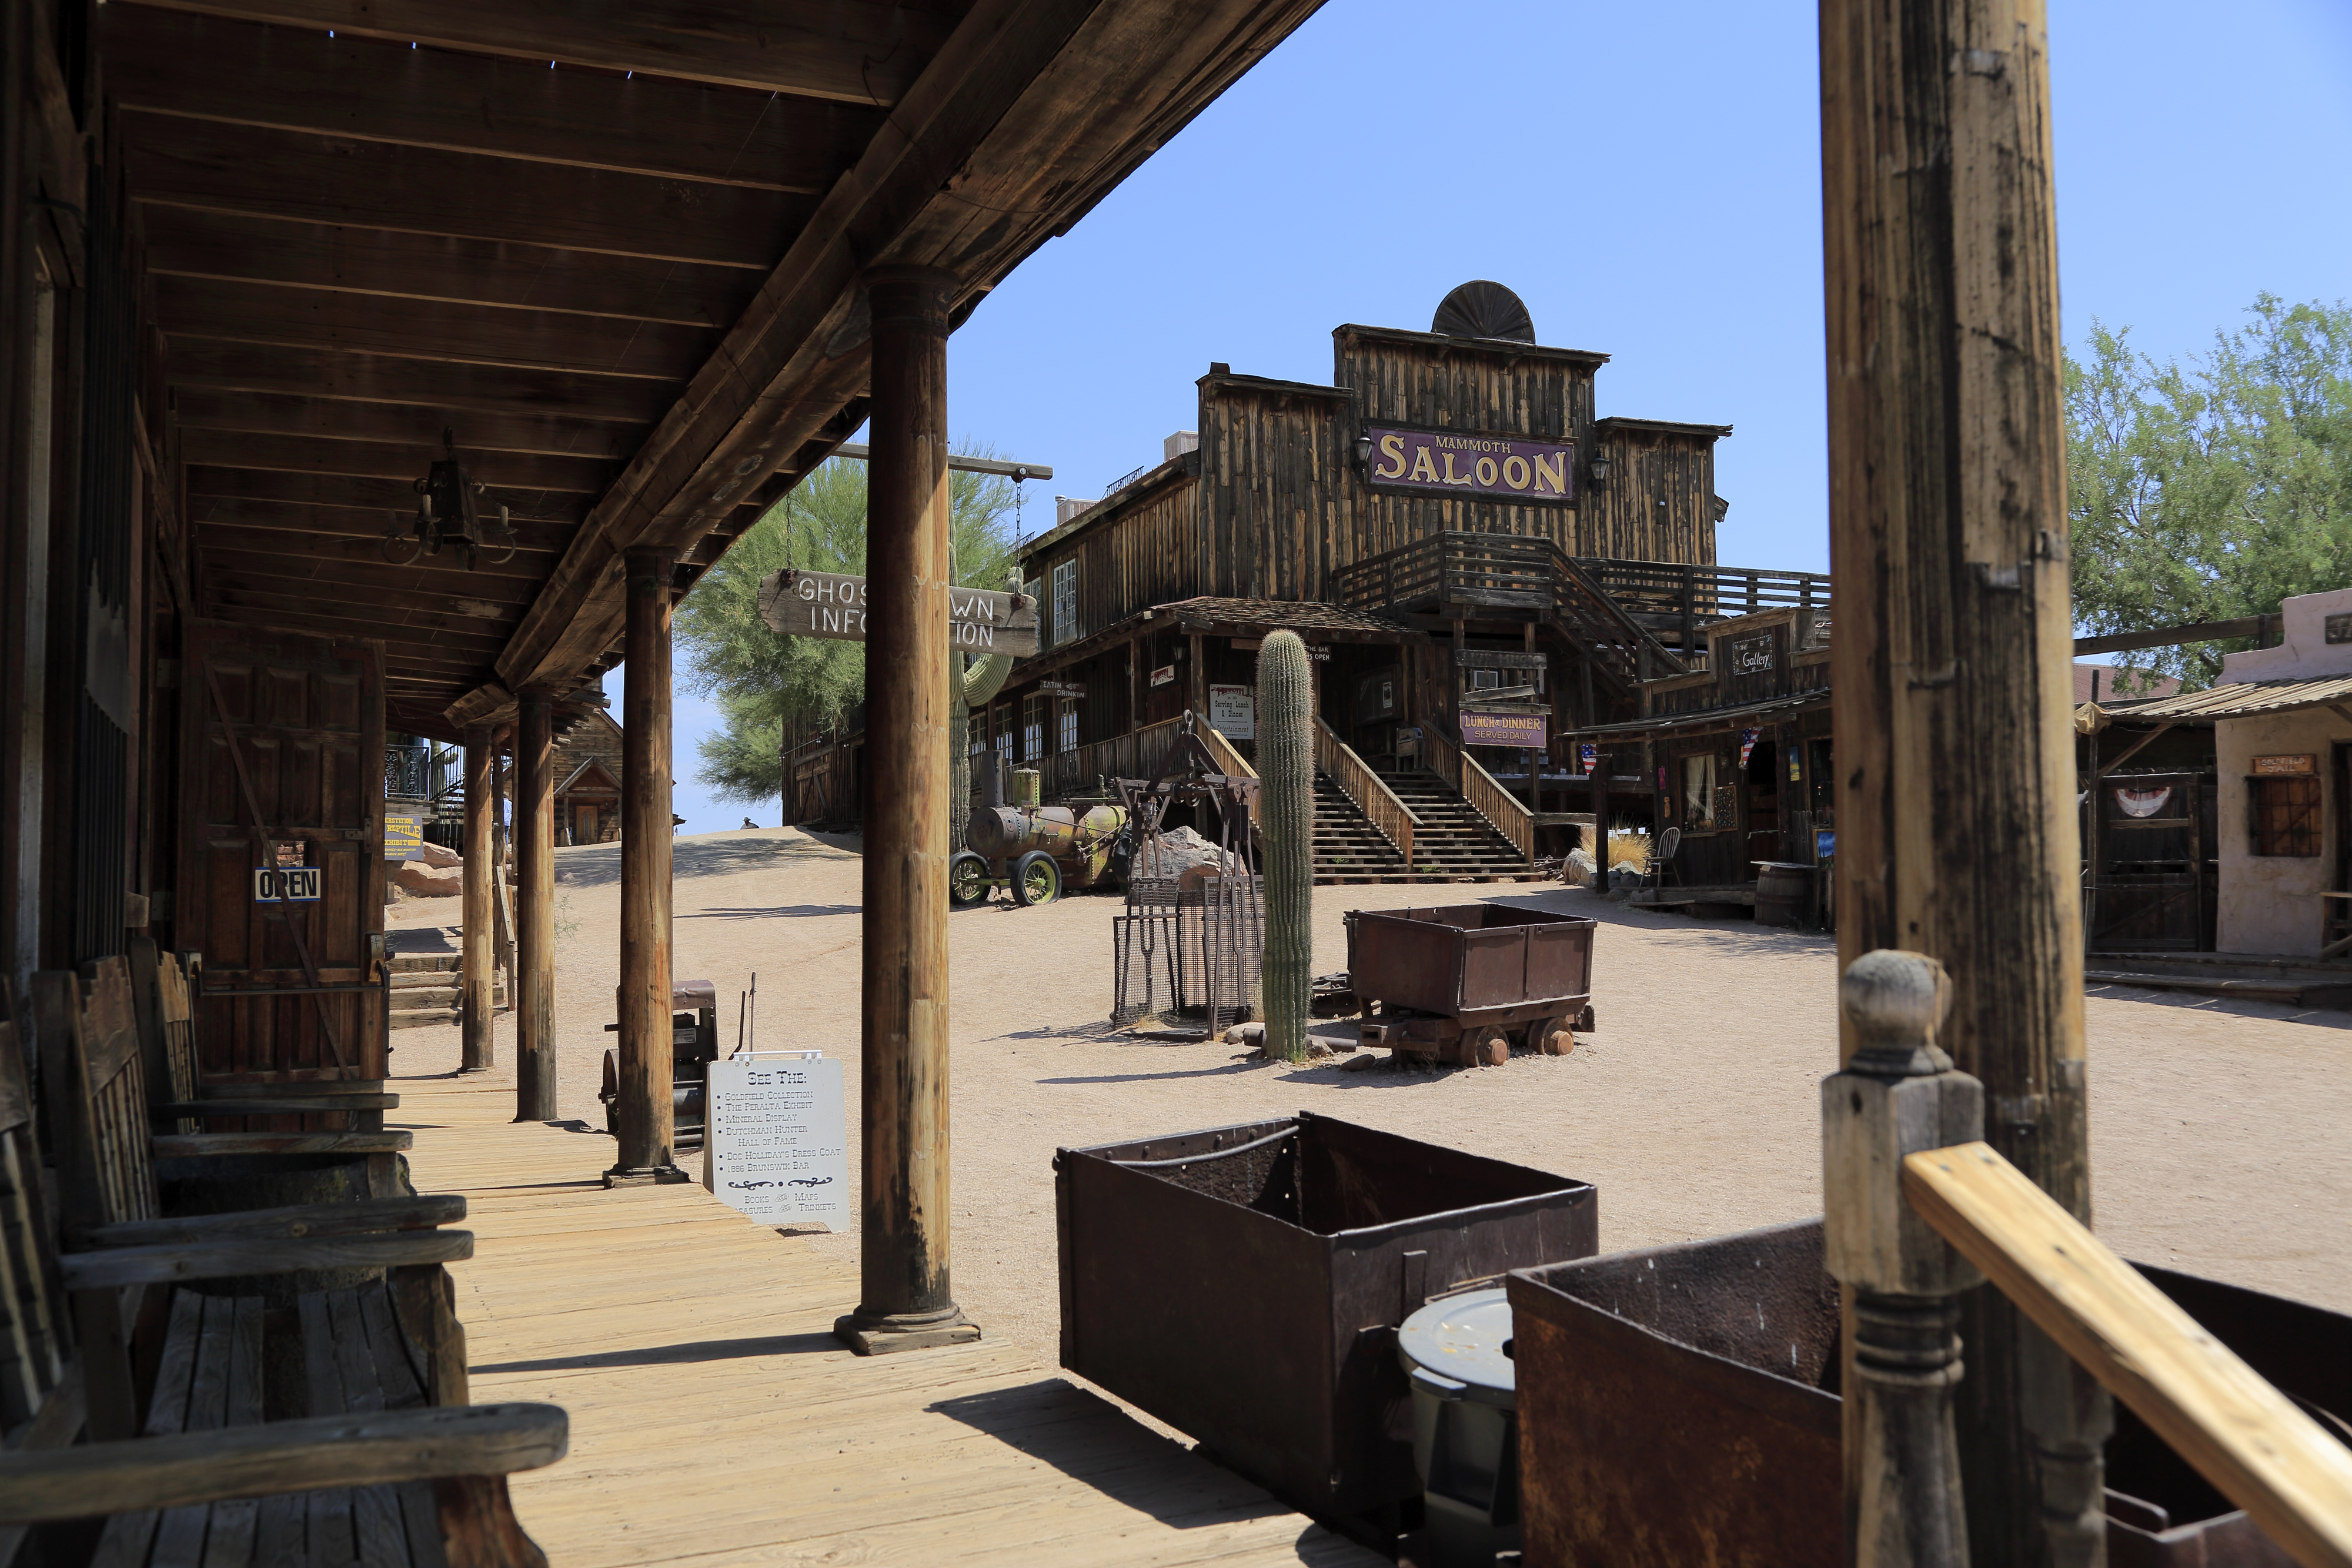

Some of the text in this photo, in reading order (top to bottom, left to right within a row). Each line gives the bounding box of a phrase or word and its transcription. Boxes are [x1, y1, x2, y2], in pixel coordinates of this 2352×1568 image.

[1435, 435, 1511, 454] MAMMOTH
[1375, 434, 1566, 494] SALOON
[1743, 651, 1770, 668] Gallery
[1043, 681, 1062, 689] EATIN
[1057, 690, 1085, 698] DRINKIN
[1215, 700, 1232, 710] Serving
[1464, 715, 1495, 728] LUNCH
[1501, 717, 1542, 731] DINNER
[1474, 730, 1532, 740] SERVED DAILY
[2261, 757, 2305, 765] GOLDFIELD
[386, 824, 420, 839] REPTILE
[260, 871, 316, 898] OPEN
[747, 1071, 807, 1085] SEE THE:
[725, 1091, 813, 1101] GOLDFIELD COLLECTION
[726, 1101, 813, 1111] THE PERALTA EXHIBIT
[726, 1114, 797, 1124] MINERAL DISPLAY
[726, 1125, 808, 1135] DUTCHMAN HUNTER
[738, 1138, 760, 1146] HALL
[774, 1136, 797, 1145] FAME
[727, 1148, 841, 1161] DOC HOLLIDAY'S DRESS COAT
[747, 1163, 790, 1172] BRUNSWIK
[793, 1161, 810, 1169] BAR
[744, 1195, 770, 1204] BOOKS
[794, 1192, 818, 1201] MAPS
[735, 1206, 773, 1215] EASURES
[798, 1203, 837, 1212] TRINKETS
